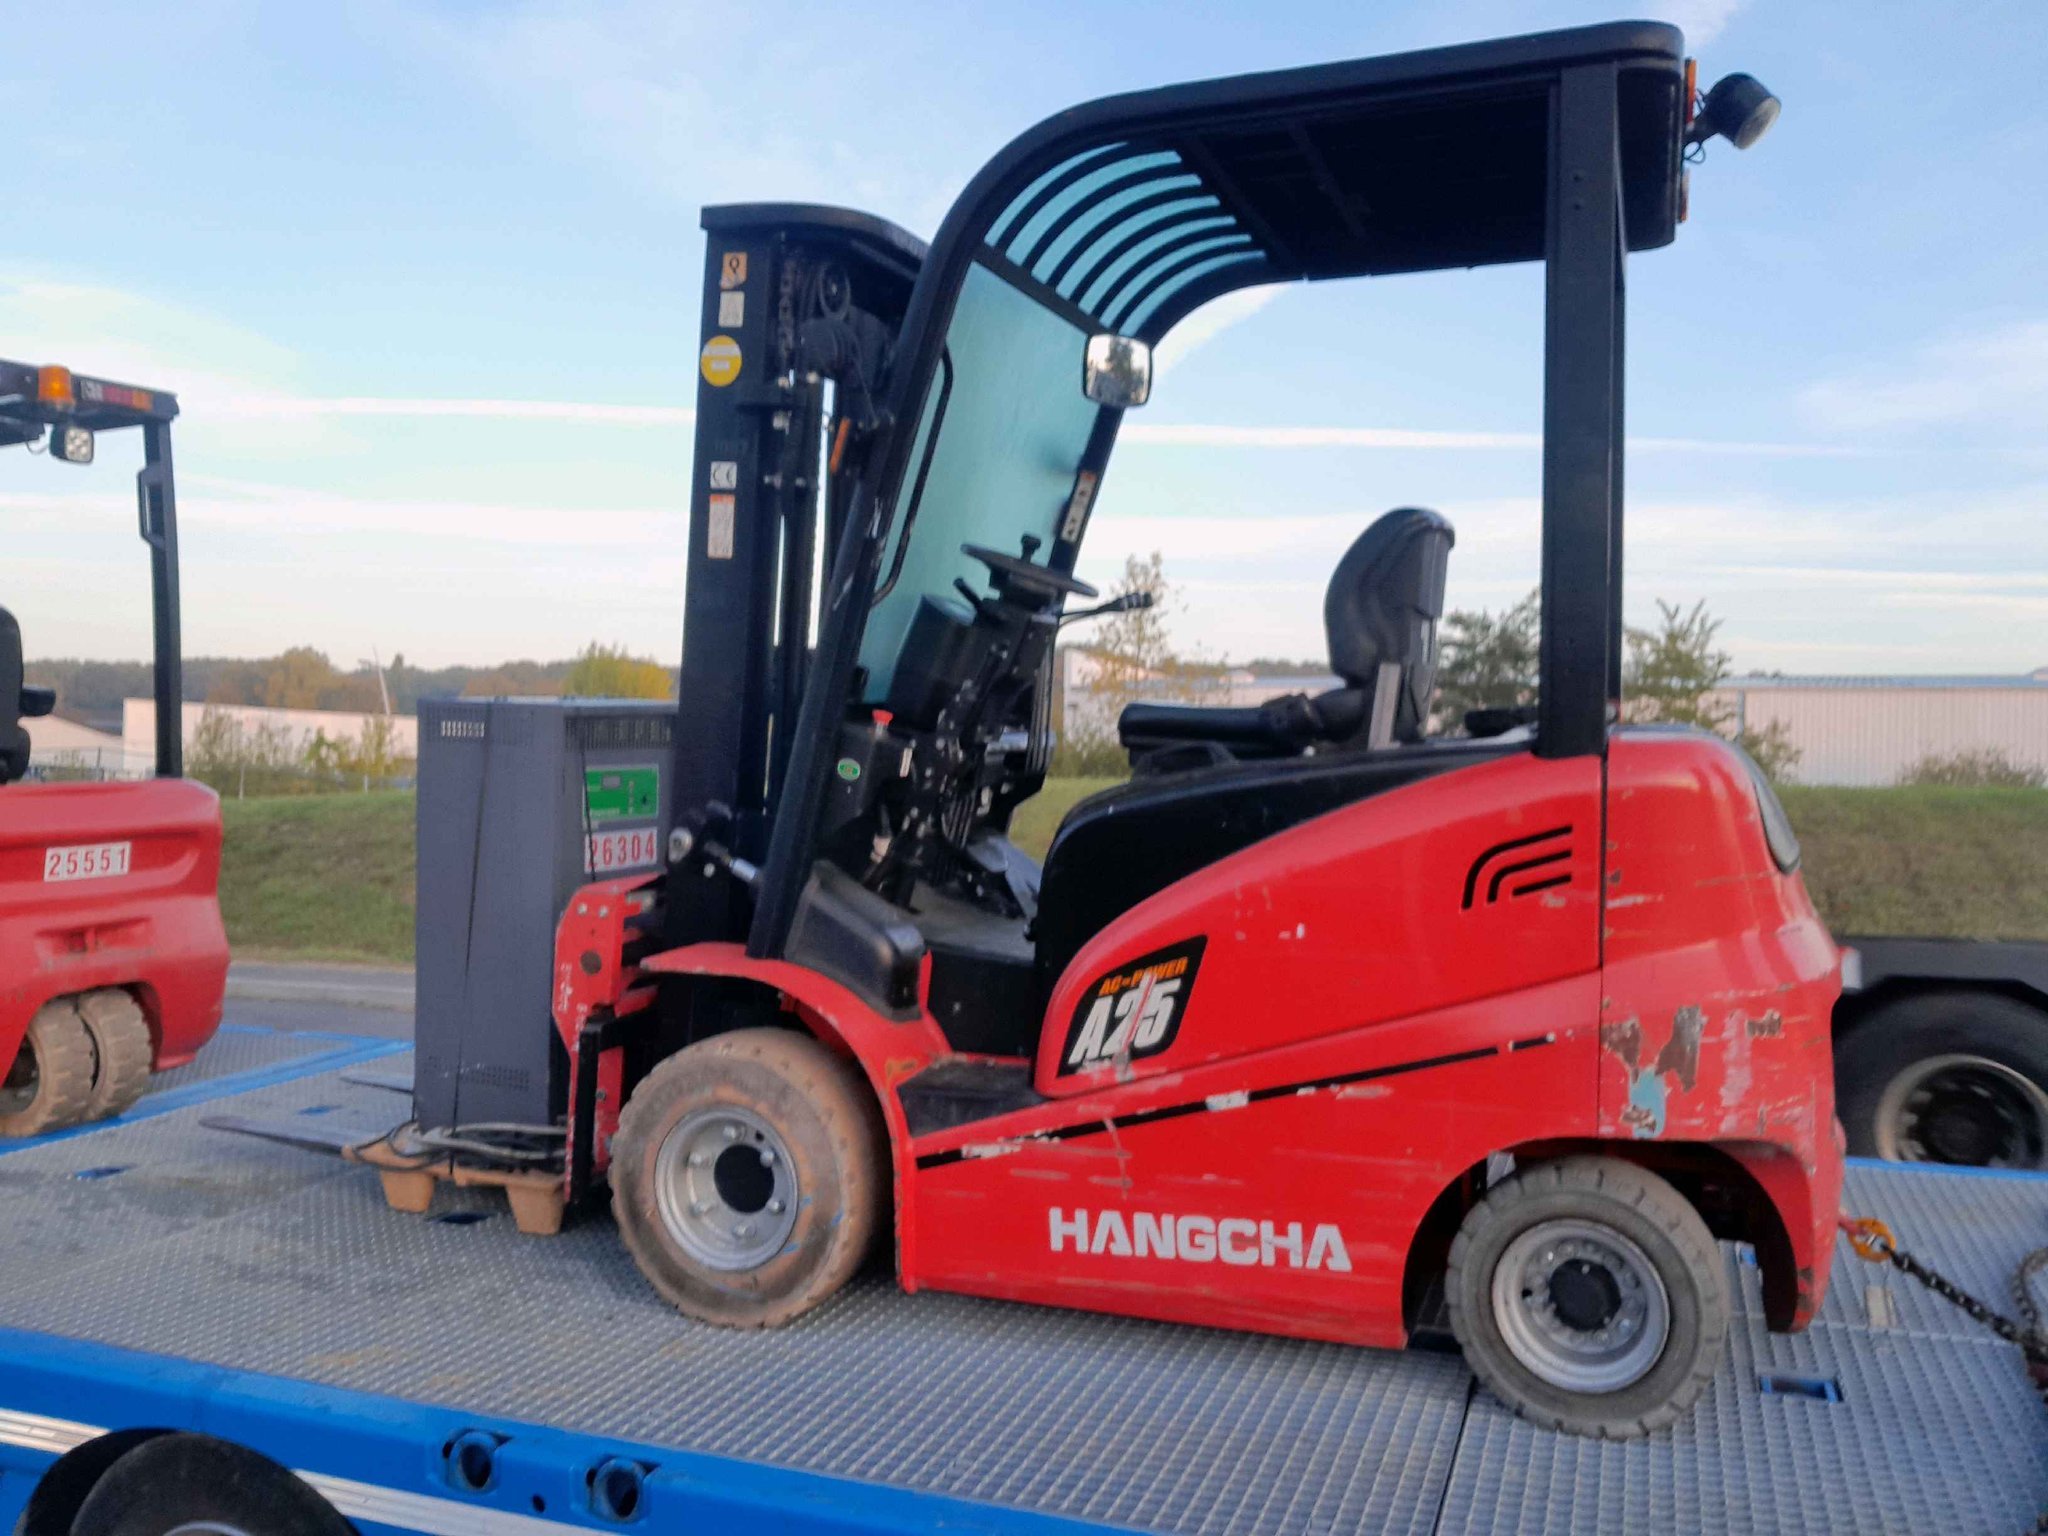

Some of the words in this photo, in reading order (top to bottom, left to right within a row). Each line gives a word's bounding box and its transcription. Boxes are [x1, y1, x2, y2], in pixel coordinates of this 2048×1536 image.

[48, 847, 126, 876] 25551
[587, 831, 655, 869] 26304
[1067, 977, 1182, 1065] A25
[1049, 1206, 1353, 1272] HANGCHA
